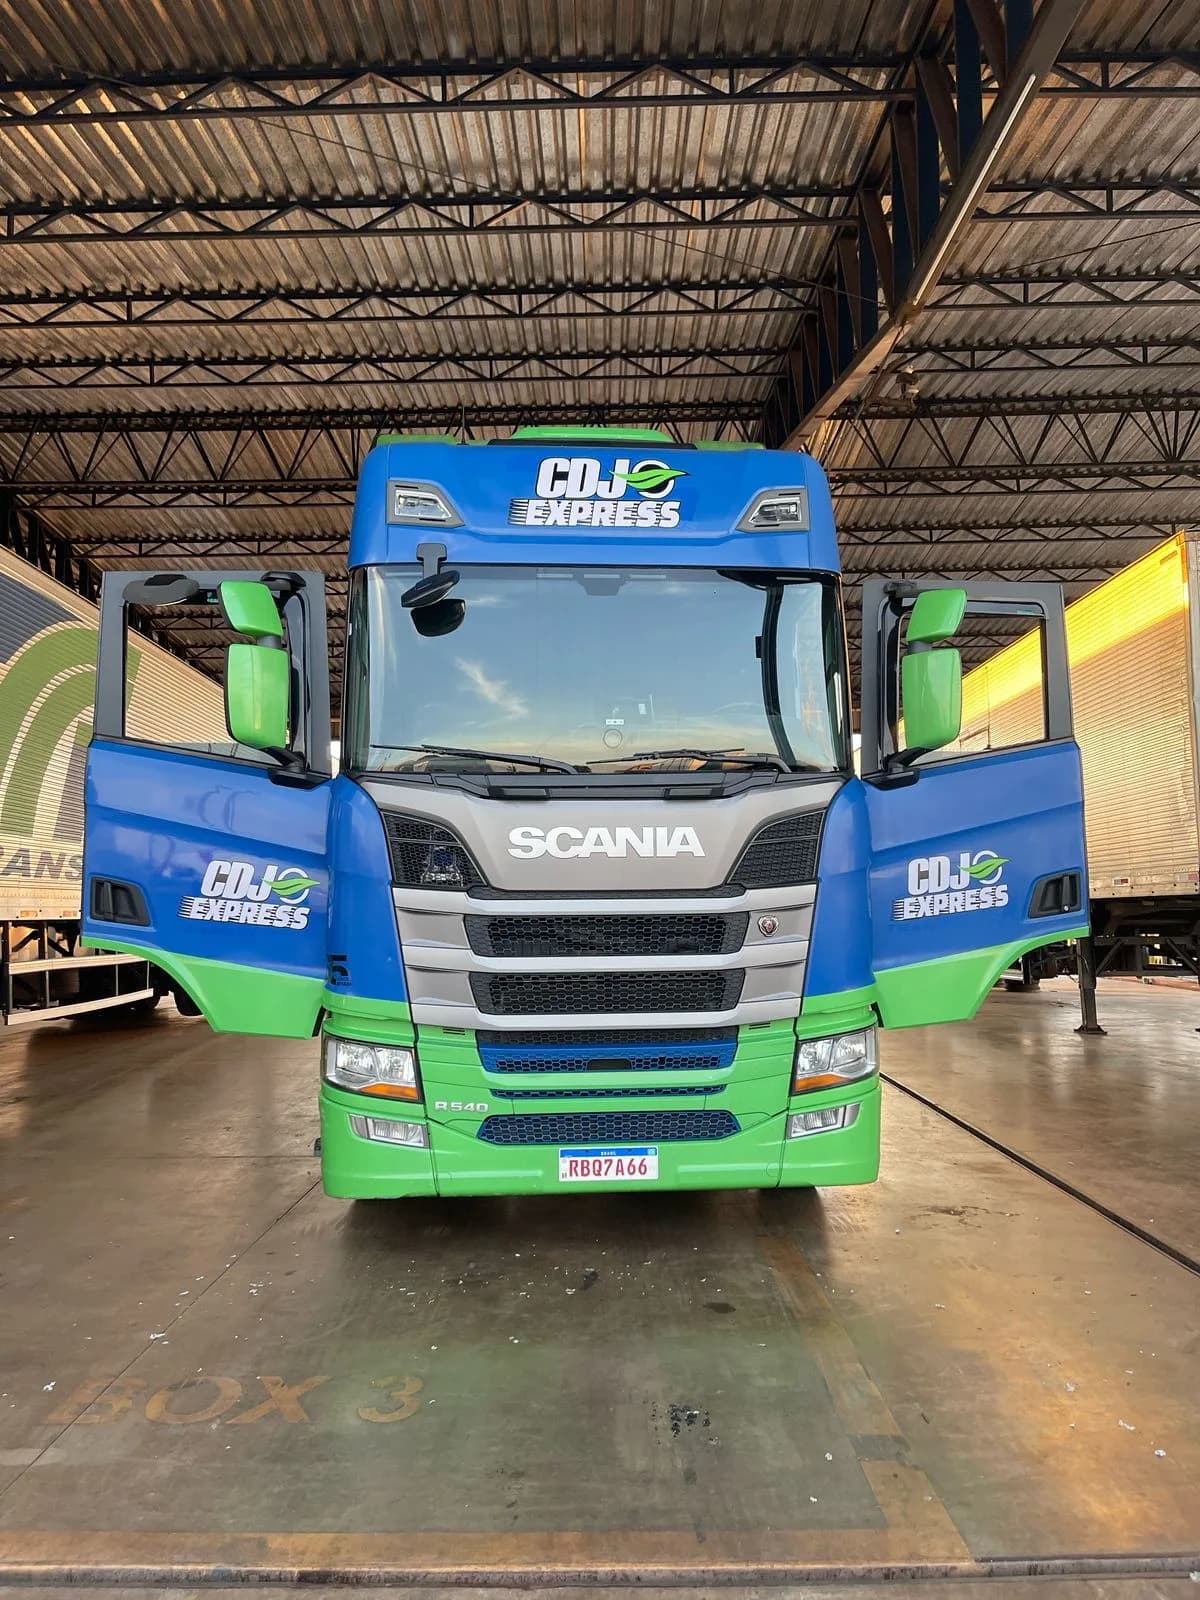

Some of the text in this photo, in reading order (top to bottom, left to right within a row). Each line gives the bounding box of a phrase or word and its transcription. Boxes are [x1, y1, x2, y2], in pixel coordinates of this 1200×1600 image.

[524, 499, 681, 529] EXPRESS
[507, 826, 706, 859] SCANIA
[0, 845, 83, 881] ANS
[188, 896, 311, 930] EXPRESS
[902, 884, 1009, 920] EXPRESS
[434, 1101, 489, 1112] R 540
[569, 1158, 648, 1178] RBQ7A66
[41, 1375, 425, 1425] BOX 3
